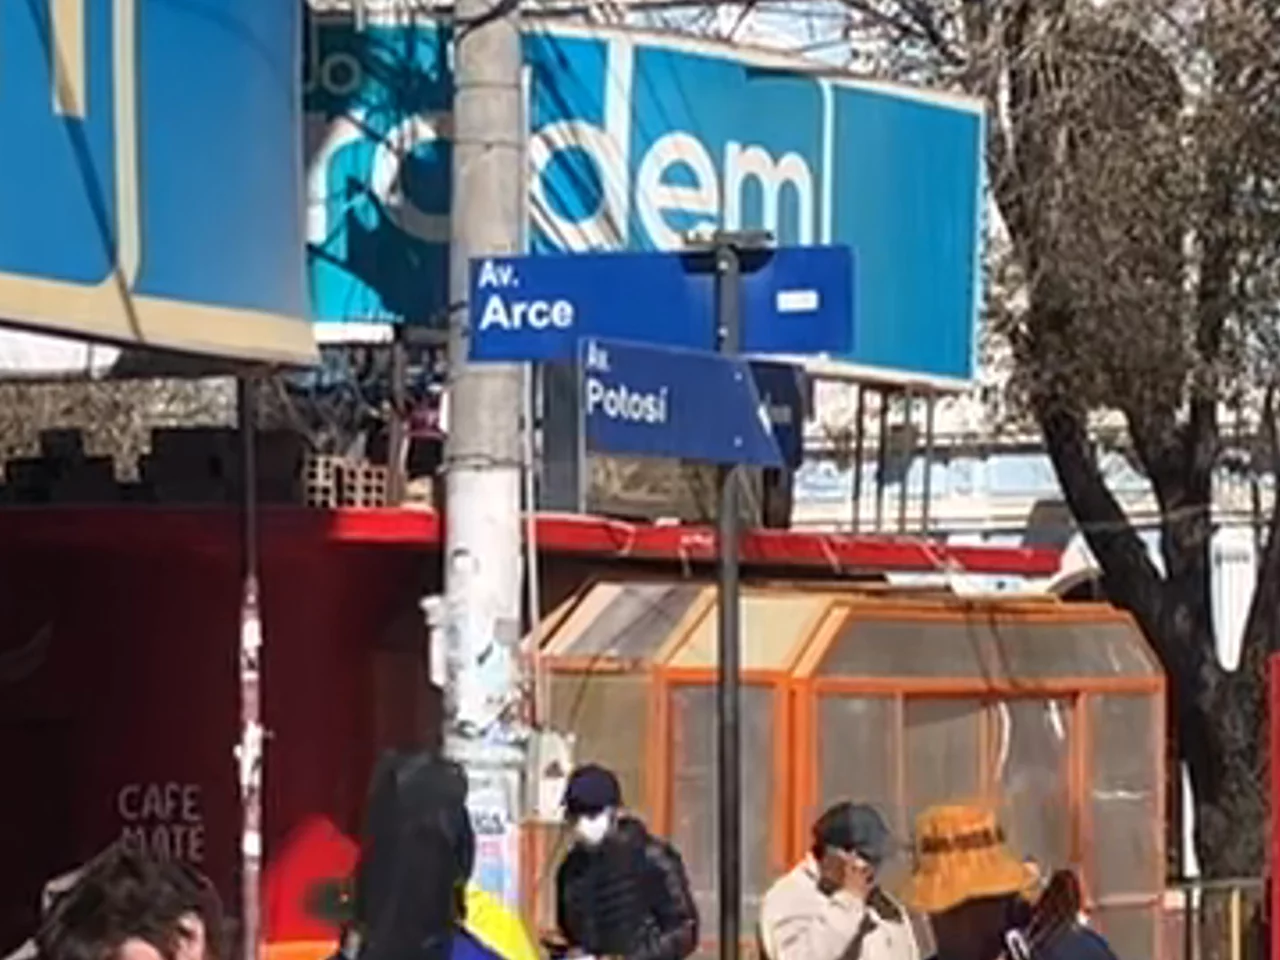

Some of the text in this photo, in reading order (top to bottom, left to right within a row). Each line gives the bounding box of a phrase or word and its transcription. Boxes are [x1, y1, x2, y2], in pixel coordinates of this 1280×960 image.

[479, 259, 519, 289] Av.
[479, 294, 573, 331] Arce
[586, 379, 668, 424] Potosí
[118, 781, 203, 821] CAFE
